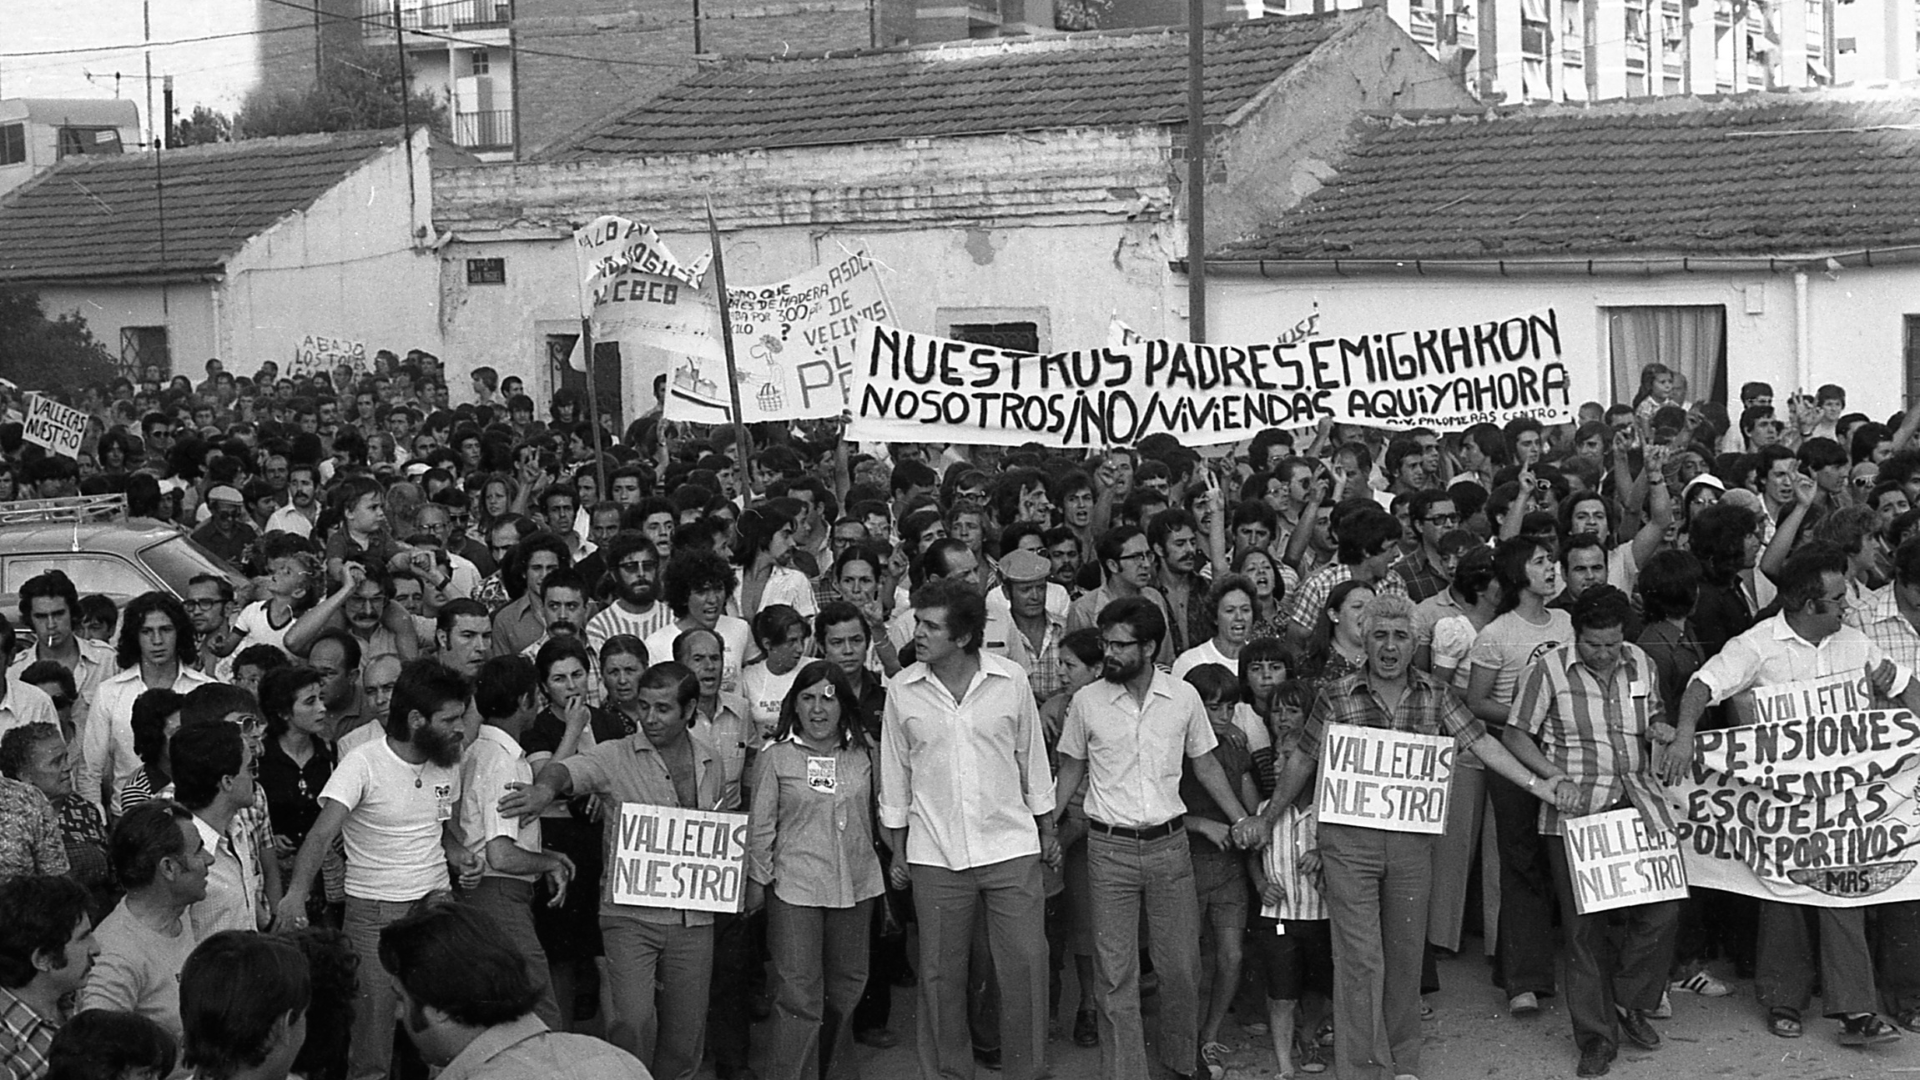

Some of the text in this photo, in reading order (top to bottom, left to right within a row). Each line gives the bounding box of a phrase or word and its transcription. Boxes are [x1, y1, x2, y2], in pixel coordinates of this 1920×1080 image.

[612, 280, 678, 305] COCO
[751, 311, 771, 322] POR
[777, 304, 808, 323] 300
[780, 284, 829, 307] MADERA
[829, 290, 853, 317] DE
[34, 397, 87, 432] VALLECAS
[861, 383, 1065, 433] NOSOTROS
[1452, 363, 1569, 412] AHORA
[1418, 411, 1497, 427] PALOMERAS
[1502, 409, 1557, 421] CENTRO
[26, 419, 79, 449] NUESTRO
[1329, 734, 1454, 783] VALLECAS
[1696, 711, 1920, 769] PENSIONES
[1322, 777, 1445, 823] NUESTRO
[1688, 784, 1888, 835] ESCUELAS
[622, 813, 747, 861] VALLECAS
[1676, 824, 1908, 877] POLIDEPORTIVOS
[614, 857, 739, 902] NUESTRO
[1578, 854, 1683, 904] NUESTRO
[1826, 870, 1870, 893] MAS
